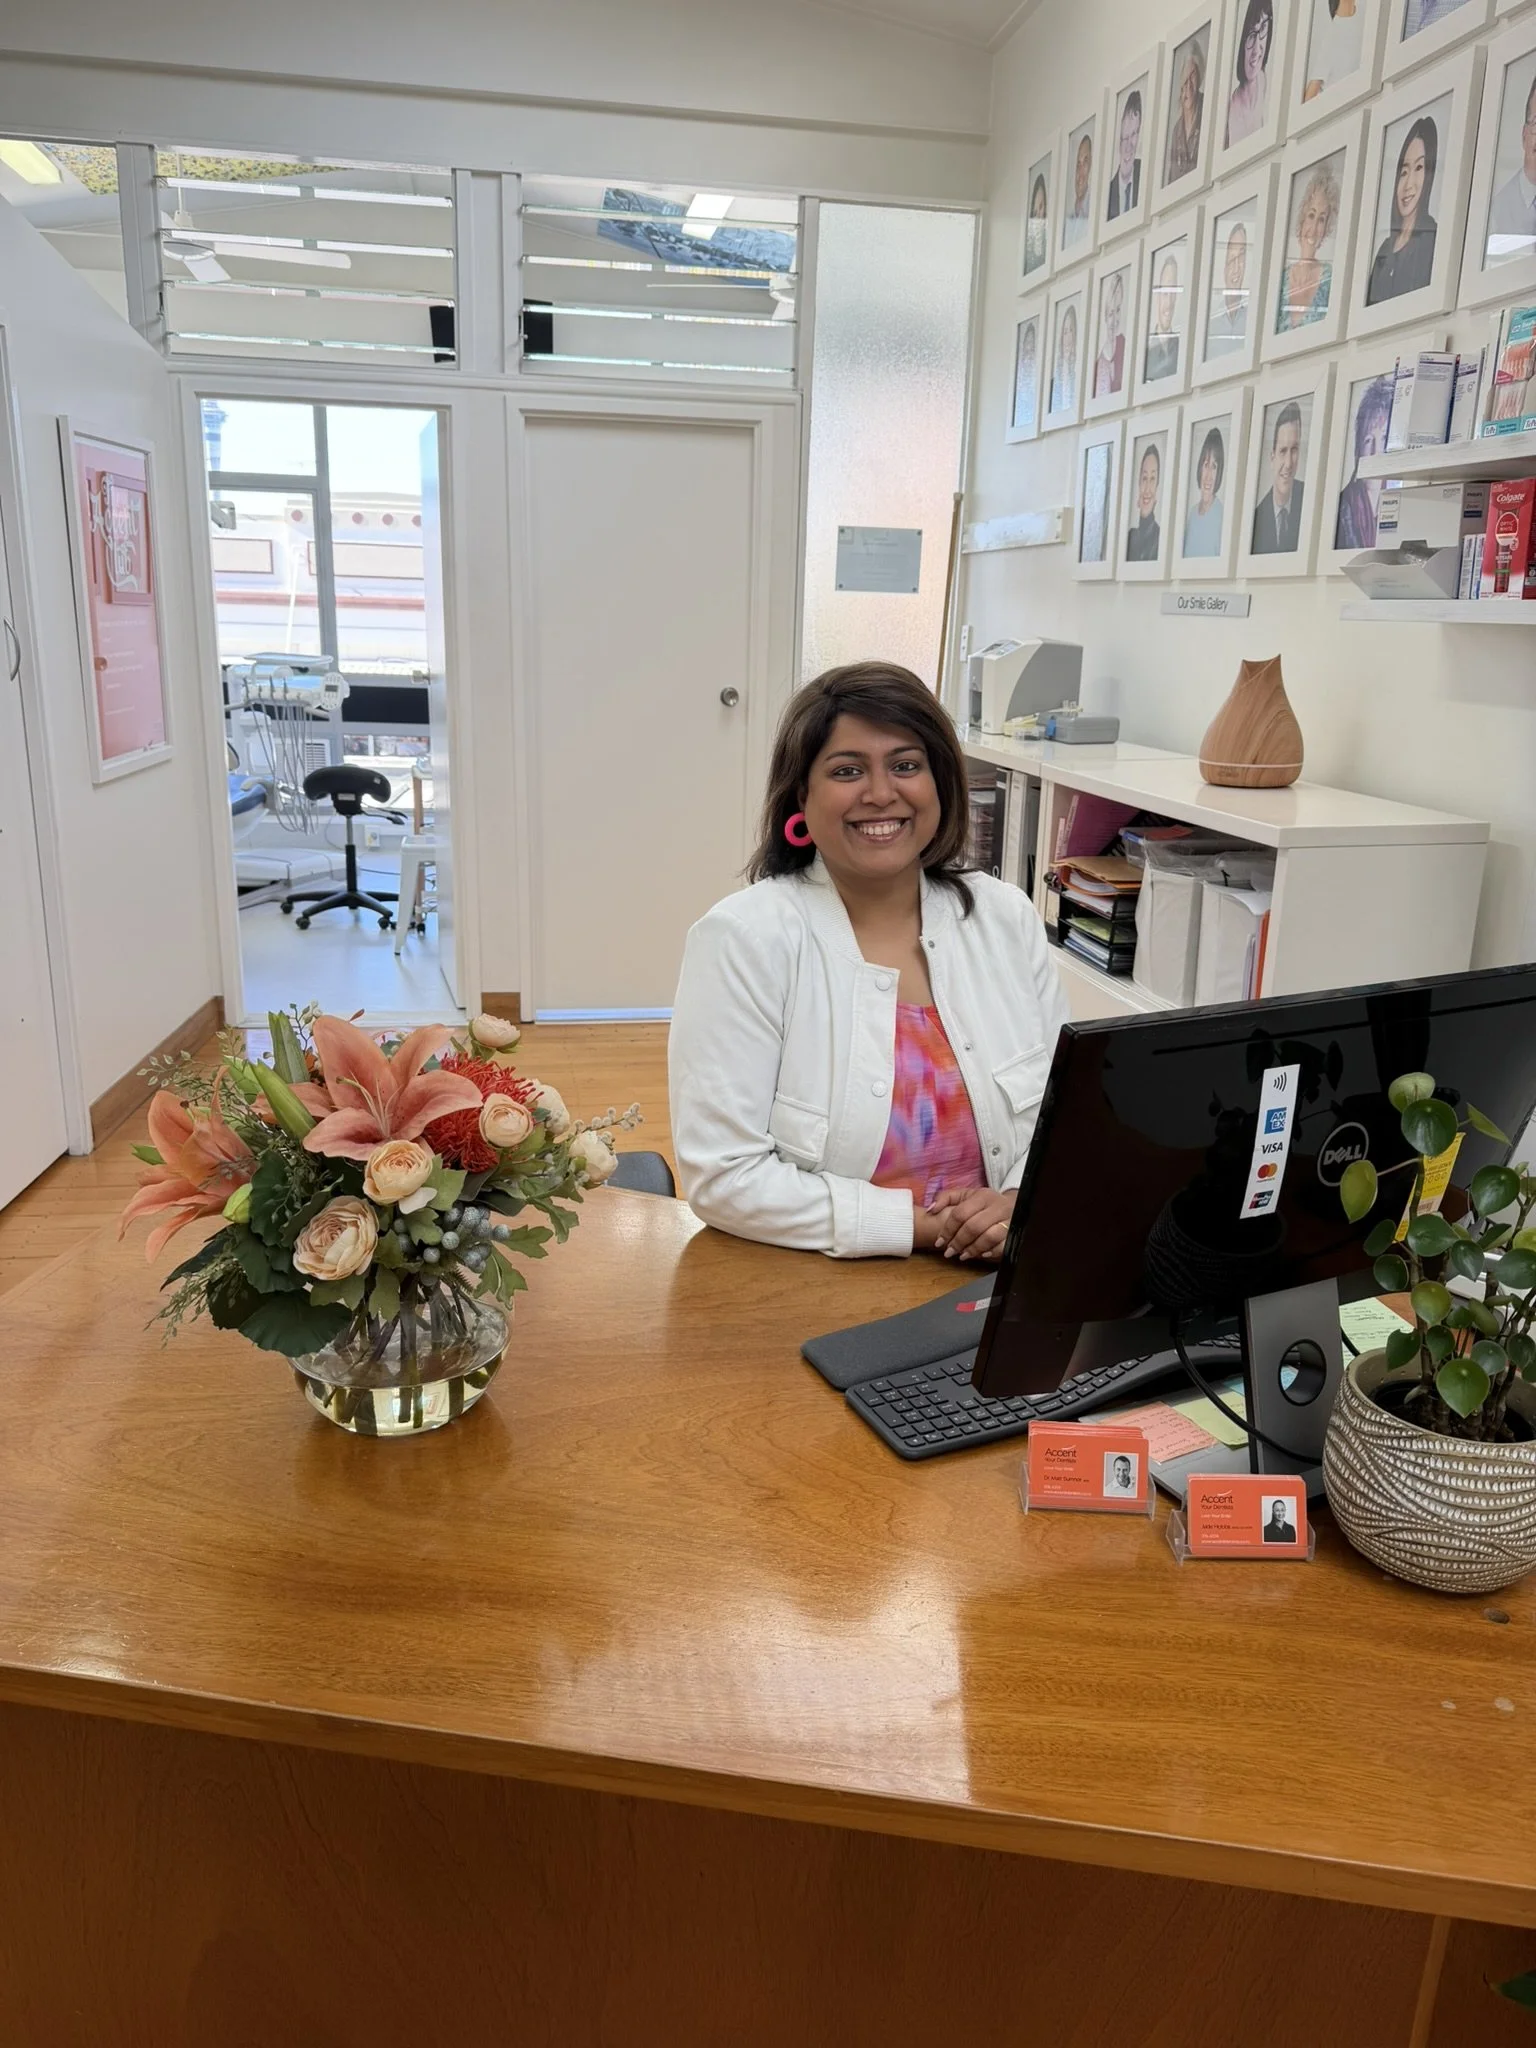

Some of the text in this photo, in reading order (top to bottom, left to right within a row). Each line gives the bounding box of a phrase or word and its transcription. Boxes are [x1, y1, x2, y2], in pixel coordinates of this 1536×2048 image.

[1496, 492, 1526, 504] Colgate
[1177, 596, 1229, 613] Our Smile Gallery
[1261, 1142, 1284, 1154] VISA
[1323, 1144, 1362, 1165] DELL
[1044, 1447, 1077, 1458] Accent
[1200, 1494, 1233, 1504] Accent
